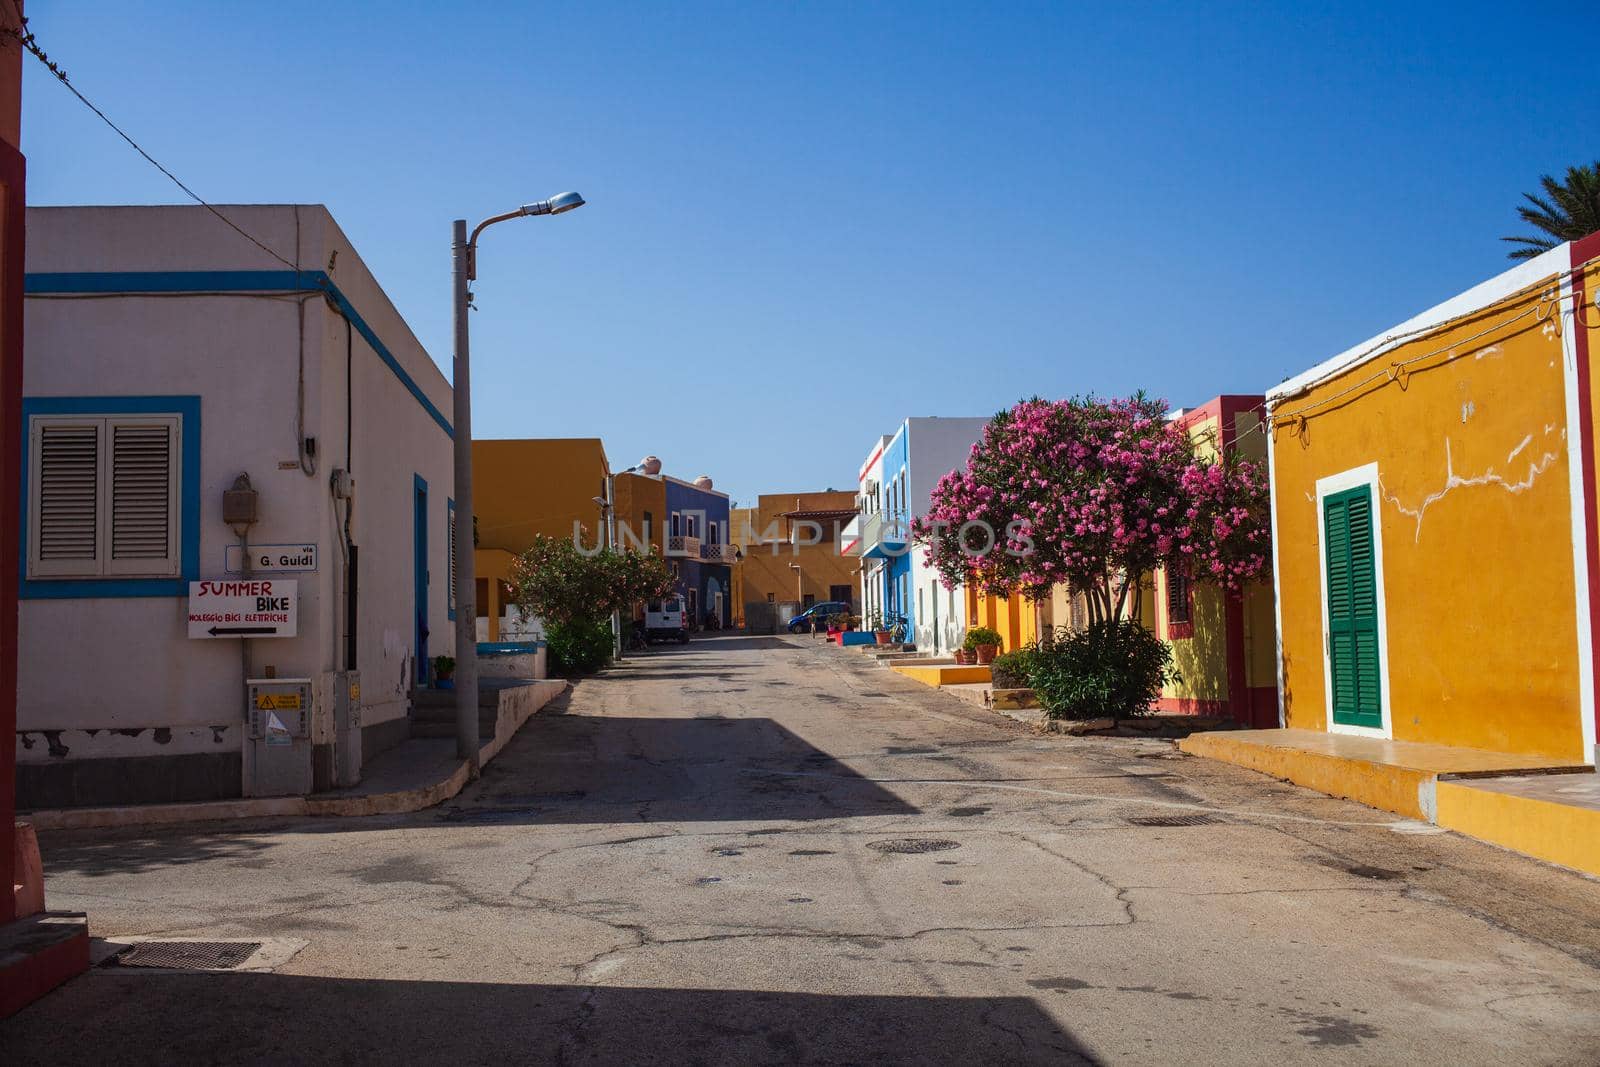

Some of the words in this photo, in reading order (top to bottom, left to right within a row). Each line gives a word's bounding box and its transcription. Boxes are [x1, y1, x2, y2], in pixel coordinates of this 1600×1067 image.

[260, 555, 274, 566] G.
[279, 555, 313, 566] Guidi
[198, 581, 272, 597] SUMMER
[256, 597, 289, 612] BIKE
[189, 613, 222, 622] NOLEGGIO
[245, 613, 288, 622] ELETTRICHE
